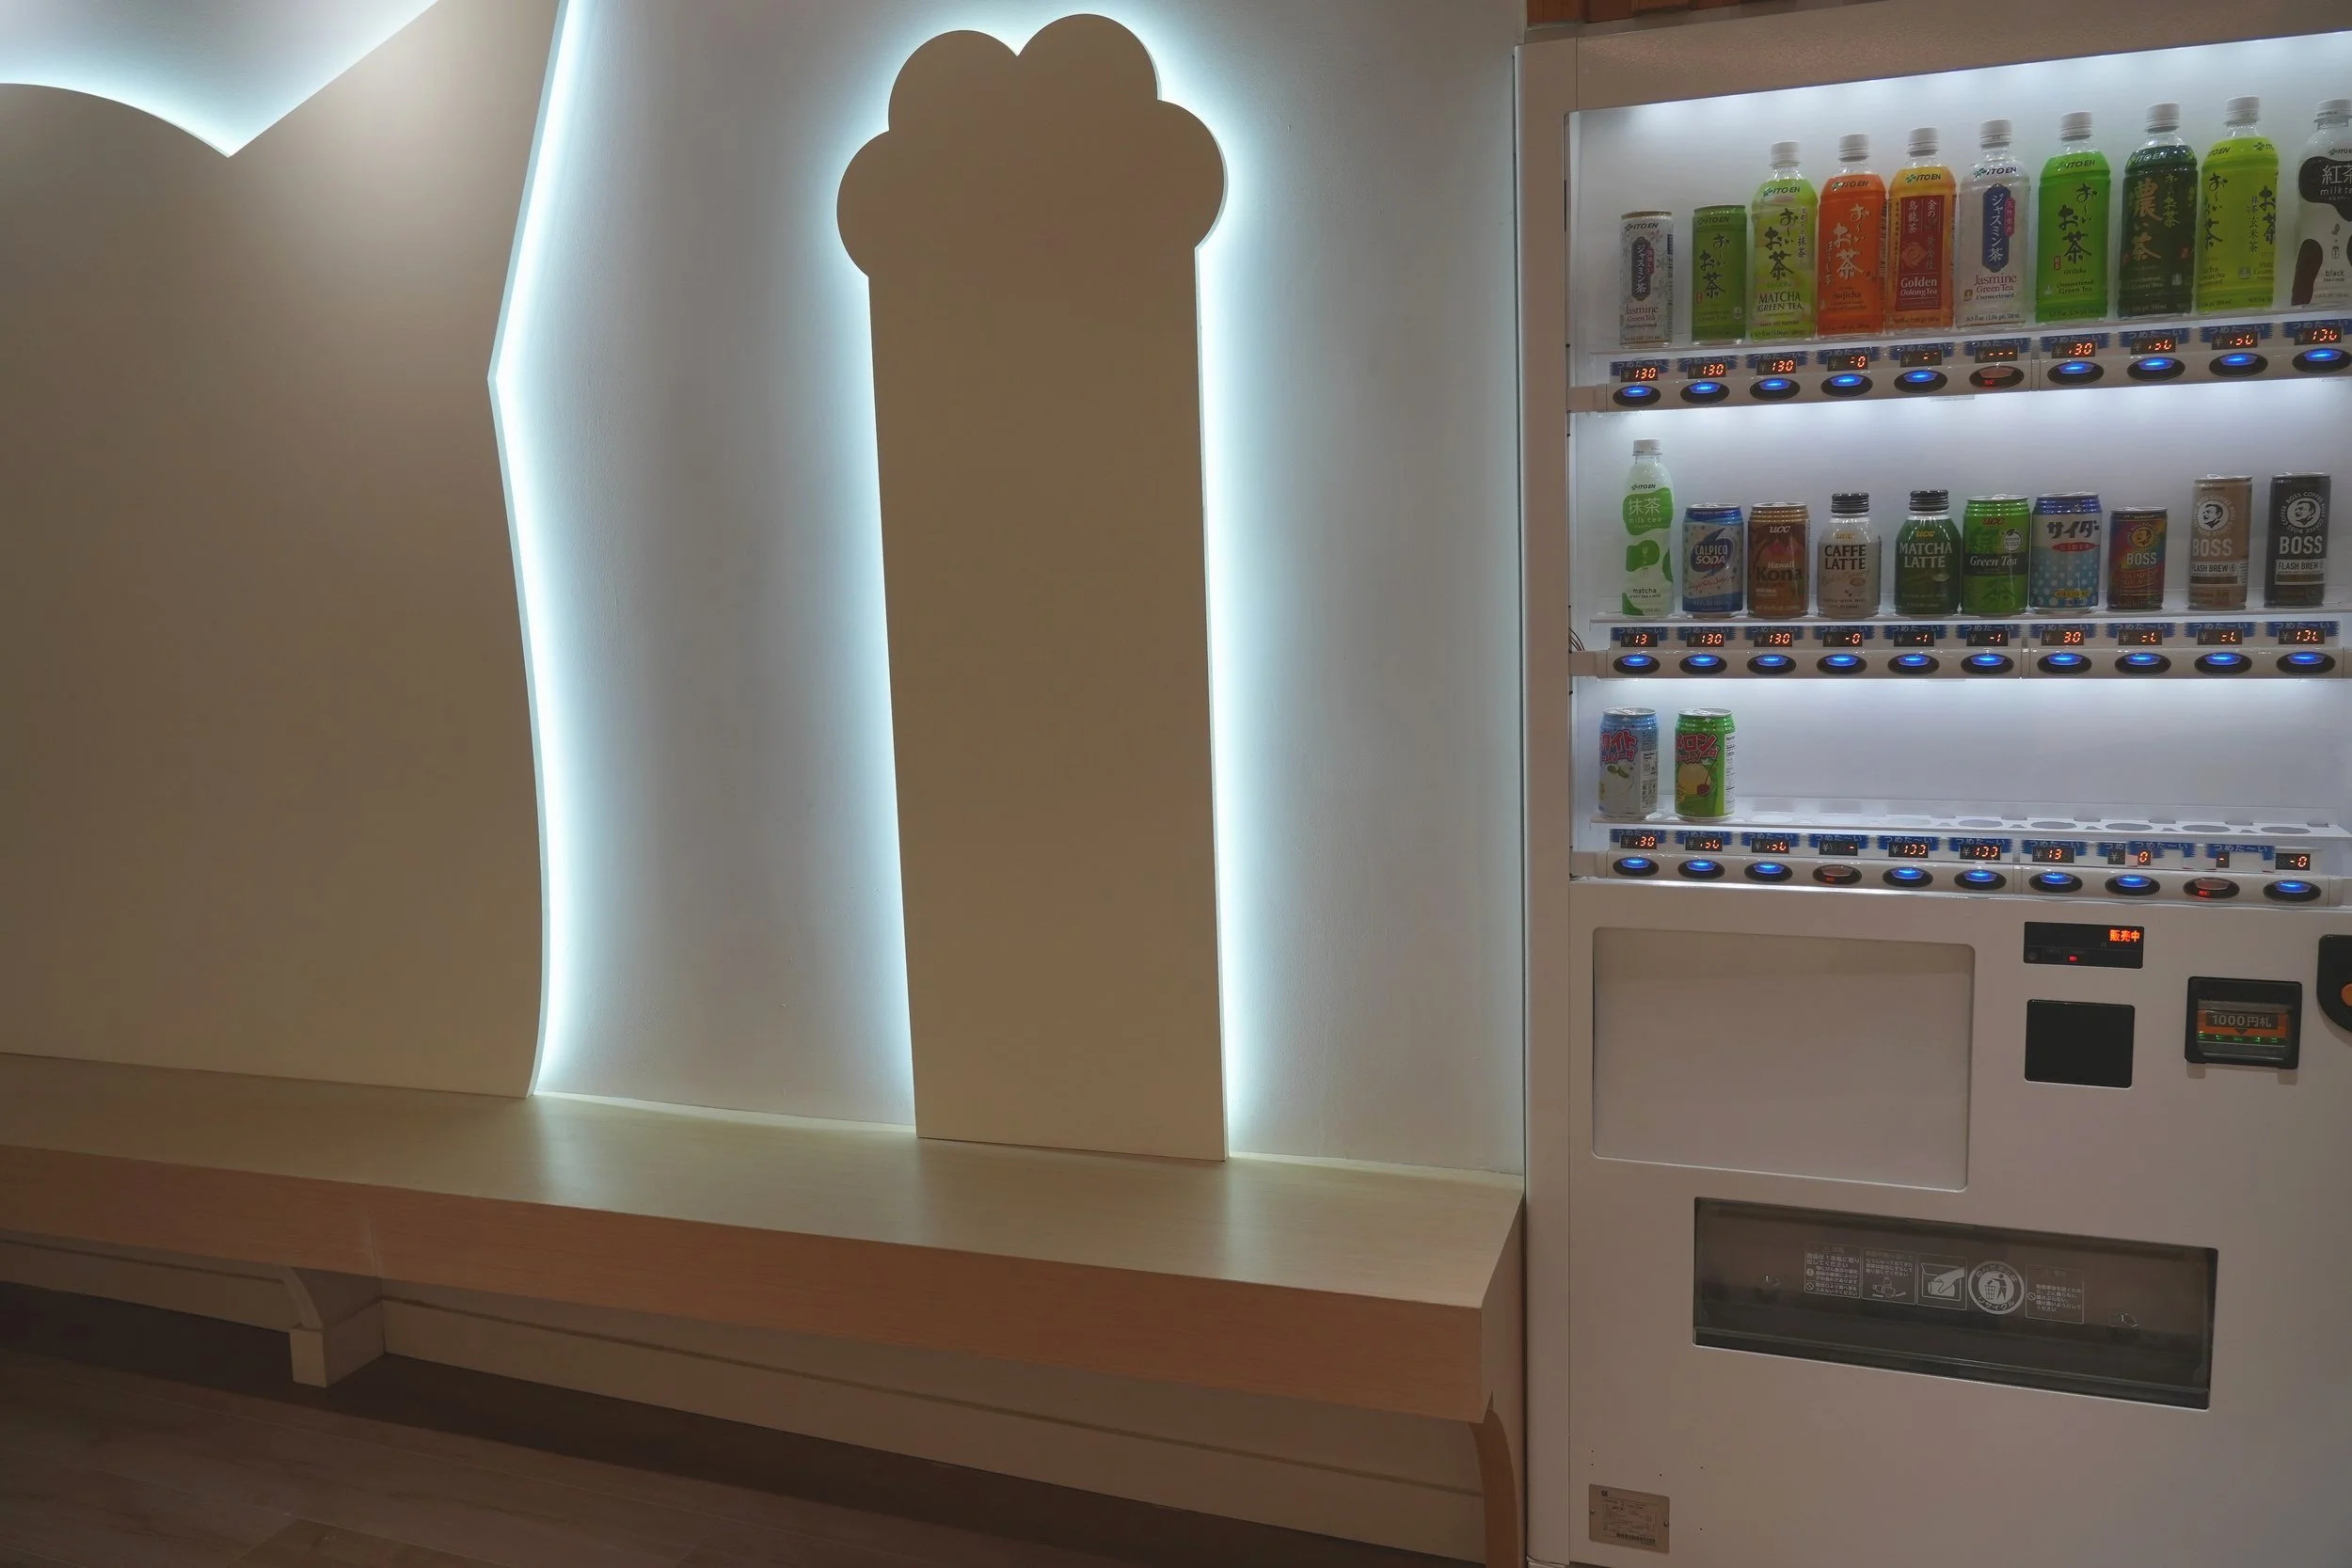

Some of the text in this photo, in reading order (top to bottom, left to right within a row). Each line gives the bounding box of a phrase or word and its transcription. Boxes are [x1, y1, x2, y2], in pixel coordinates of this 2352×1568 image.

[1927, 199, 1938, 217] 金の
[2132, 177, 2163, 261] 濃い茶
[1987, 194, 2005, 263] ジャスミン茶
[2058, 204, 2092, 263] お茶
[1765, 226, 1794, 280] お茶
[1834, 222, 1865, 280] お茶
[1635, 245, 1646, 293] ジャスミン茶
[1900, 277, 1938, 289] Golden
[1975, 273, 2018, 284] Jasmine
[1900, 287, 1938, 297] Oolong Tea
[1976, 285, 2000, 293] Green
[1758, 292, 1801, 304] MATCHA
[1833, 292, 1862, 301] Hojicha
[1626, 303, 1659, 316] Jasmine
[1757, 301, 1803, 312] GREEN TEA
[1703, 363, 1724, 376] 130
[1772, 359, 1793, 372] 130
[1635, 368, 1656, 379] 130
[2286, 491, 2324, 504] BOSS COFFEE
[1628, 498, 1661, 515] 抹茶
[1629, 516, 1645, 525] milk
[1694, 544, 1727, 557] CALPICO
[1824, 544, 1867, 557] CAFFE
[1899, 542, 1953, 555] MATCHA
[2192, 538, 2233, 557] BOSS
[2279, 536, 2324, 554] BOSS
[1695, 555, 1726, 564] SODA
[1825, 558, 1867, 570] LATTE
[1904, 556, 1946, 568] LATTE
[1970, 555, 2017, 568] Green Tea
[2126, 552, 2156, 564] BOSS
[1768, 561, 1795, 569] Hawaii
[2300, 562, 2318, 570] BREW
[1756, 566, 1803, 581] Kona
[1701, 634, 1722, 644] 130
[1769, 634, 1790, 643] 130
[2063, 632, 2081, 643] 30
[2047, 848, 2062, 860] 13
[2109, 929, 2140, 942] 販売中
[2212, 1015, 2273, 1027] 1000円札
[1978, 1295, 2015, 1311] リサイクル
